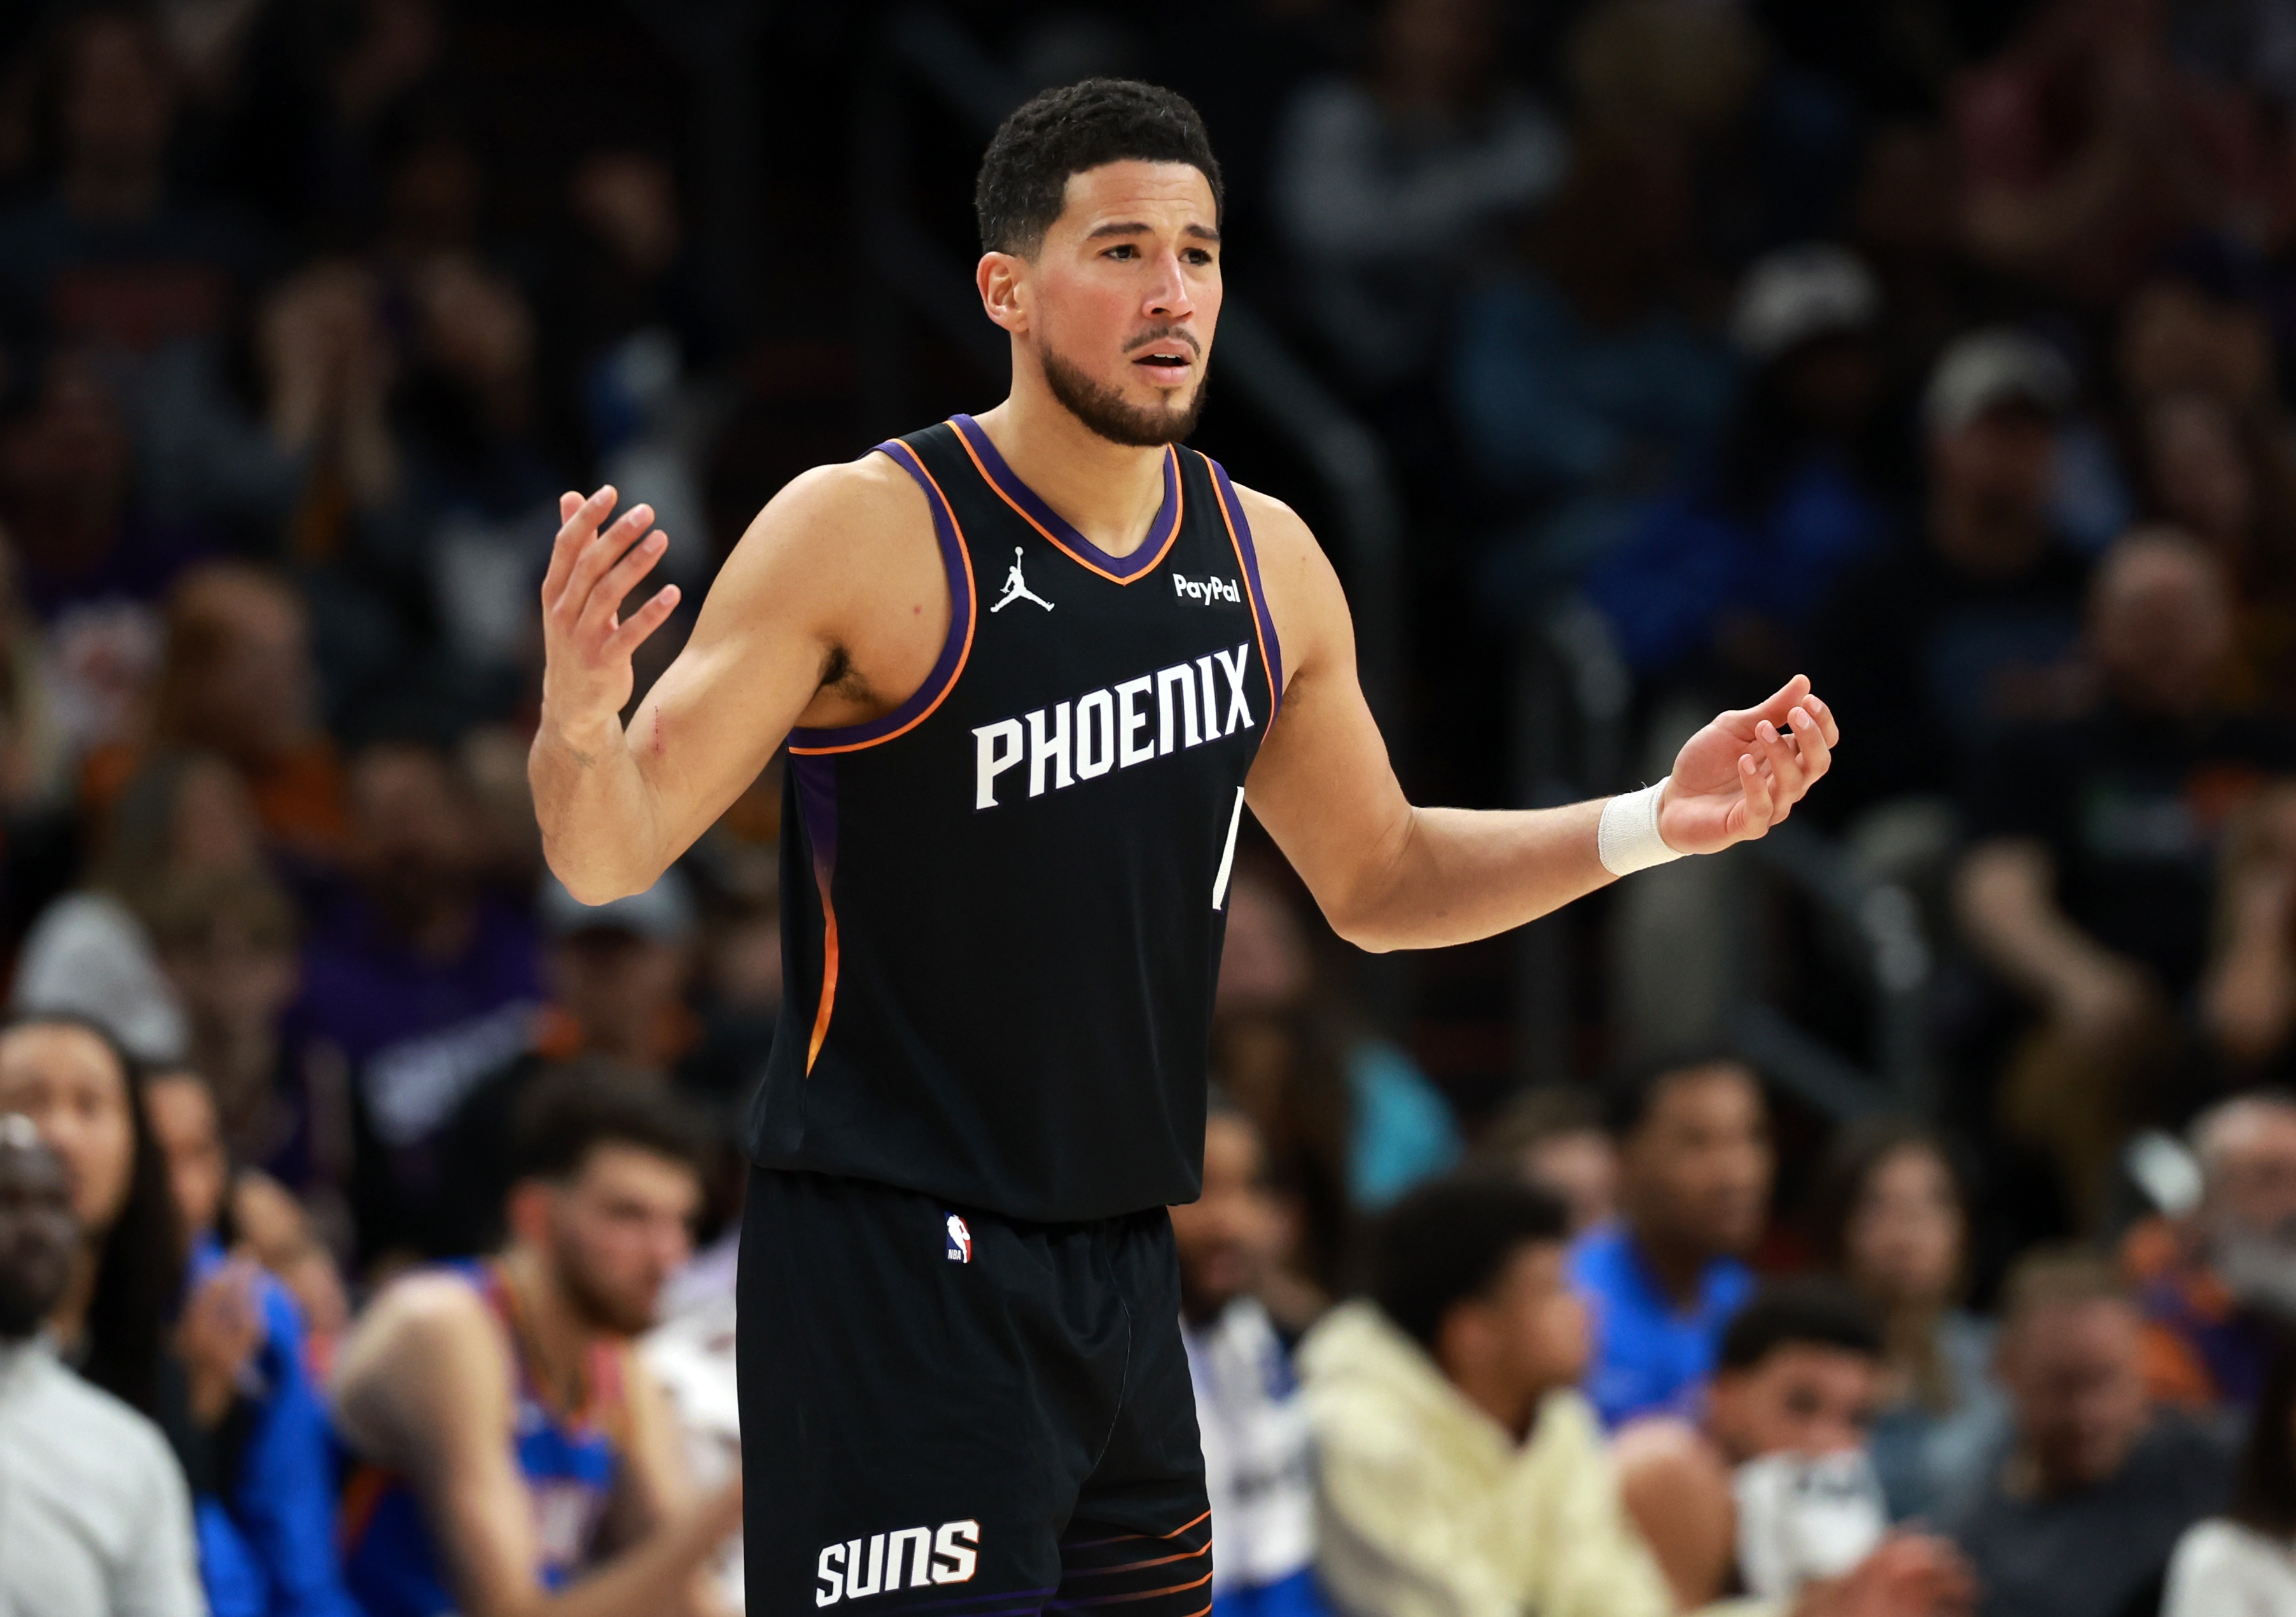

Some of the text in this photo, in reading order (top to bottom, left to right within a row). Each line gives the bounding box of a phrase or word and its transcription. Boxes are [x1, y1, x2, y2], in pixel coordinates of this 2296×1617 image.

[1173, 573, 1240, 605] PayPal
[971, 643, 1255, 810] PHOENIX
[948, 1249, 961, 1261] NBA
[816, 1521, 979, 1607] SUNS
